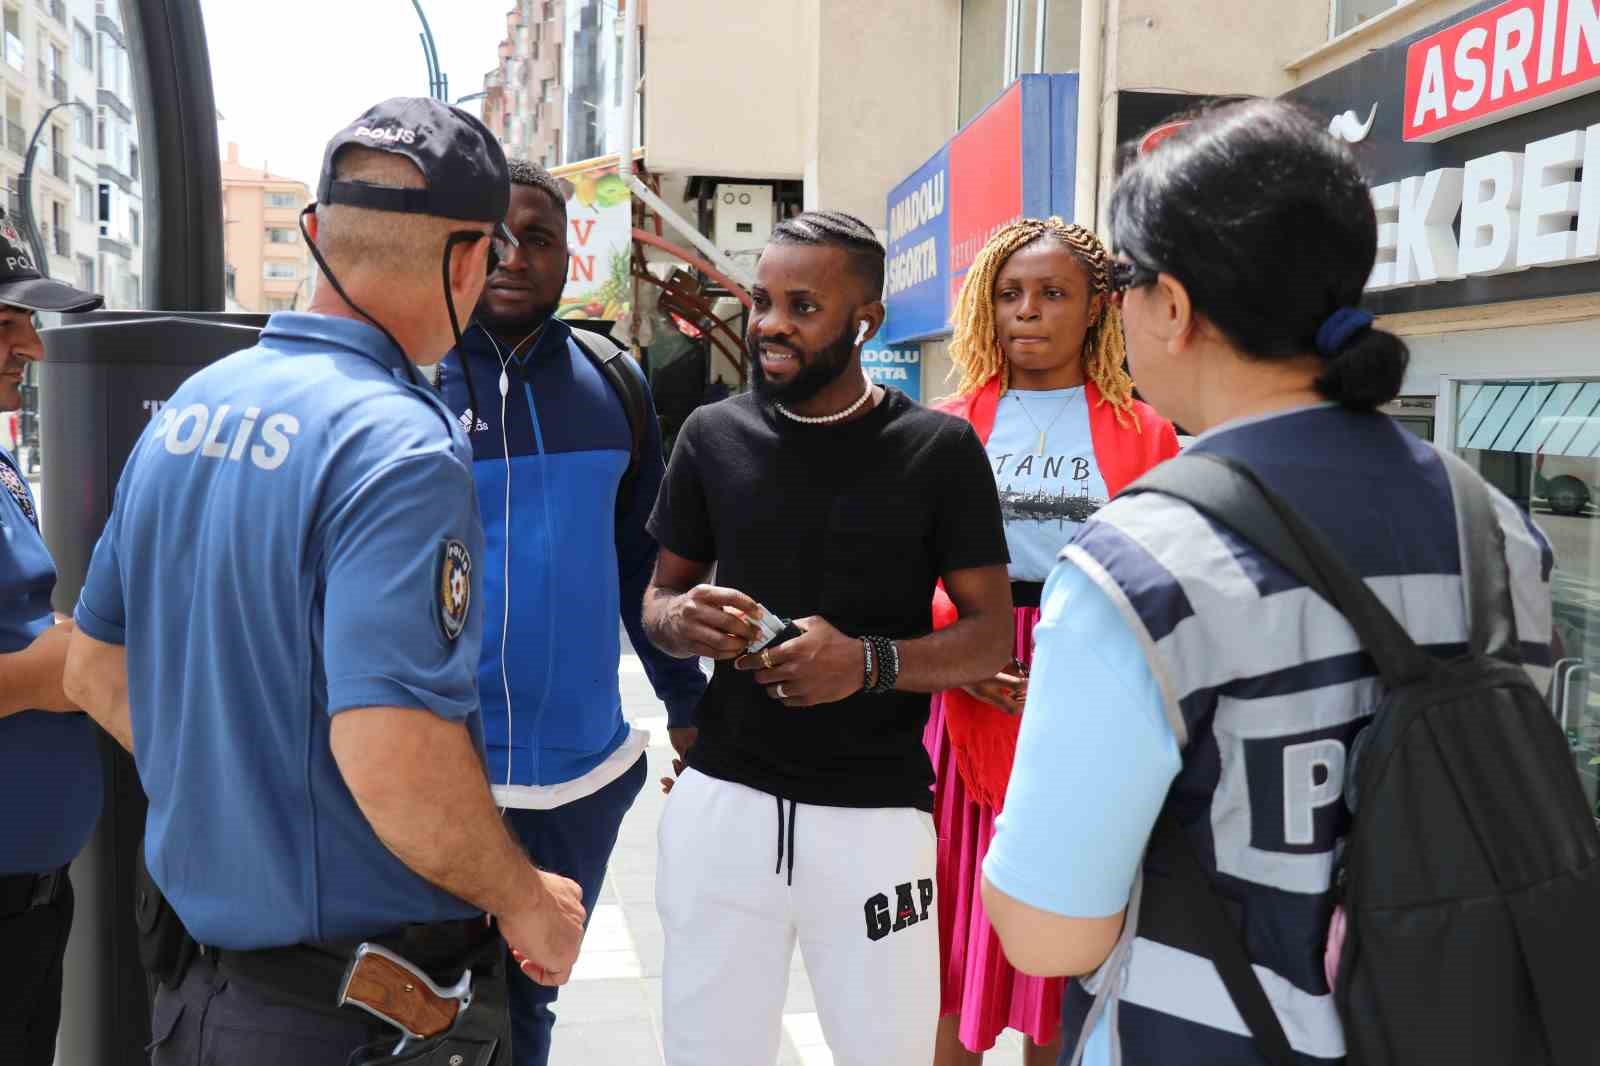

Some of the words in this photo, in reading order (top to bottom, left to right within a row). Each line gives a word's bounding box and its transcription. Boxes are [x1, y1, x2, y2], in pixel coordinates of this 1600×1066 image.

[889, 168, 944, 243] ANADOLU
[861, 349, 920, 364] DOLU
[864, 367, 908, 380] RTA
[996, 453, 1090, 481] TANB
[1283, 739, 1346, 844] P
[864, 878, 933, 942] GAP
